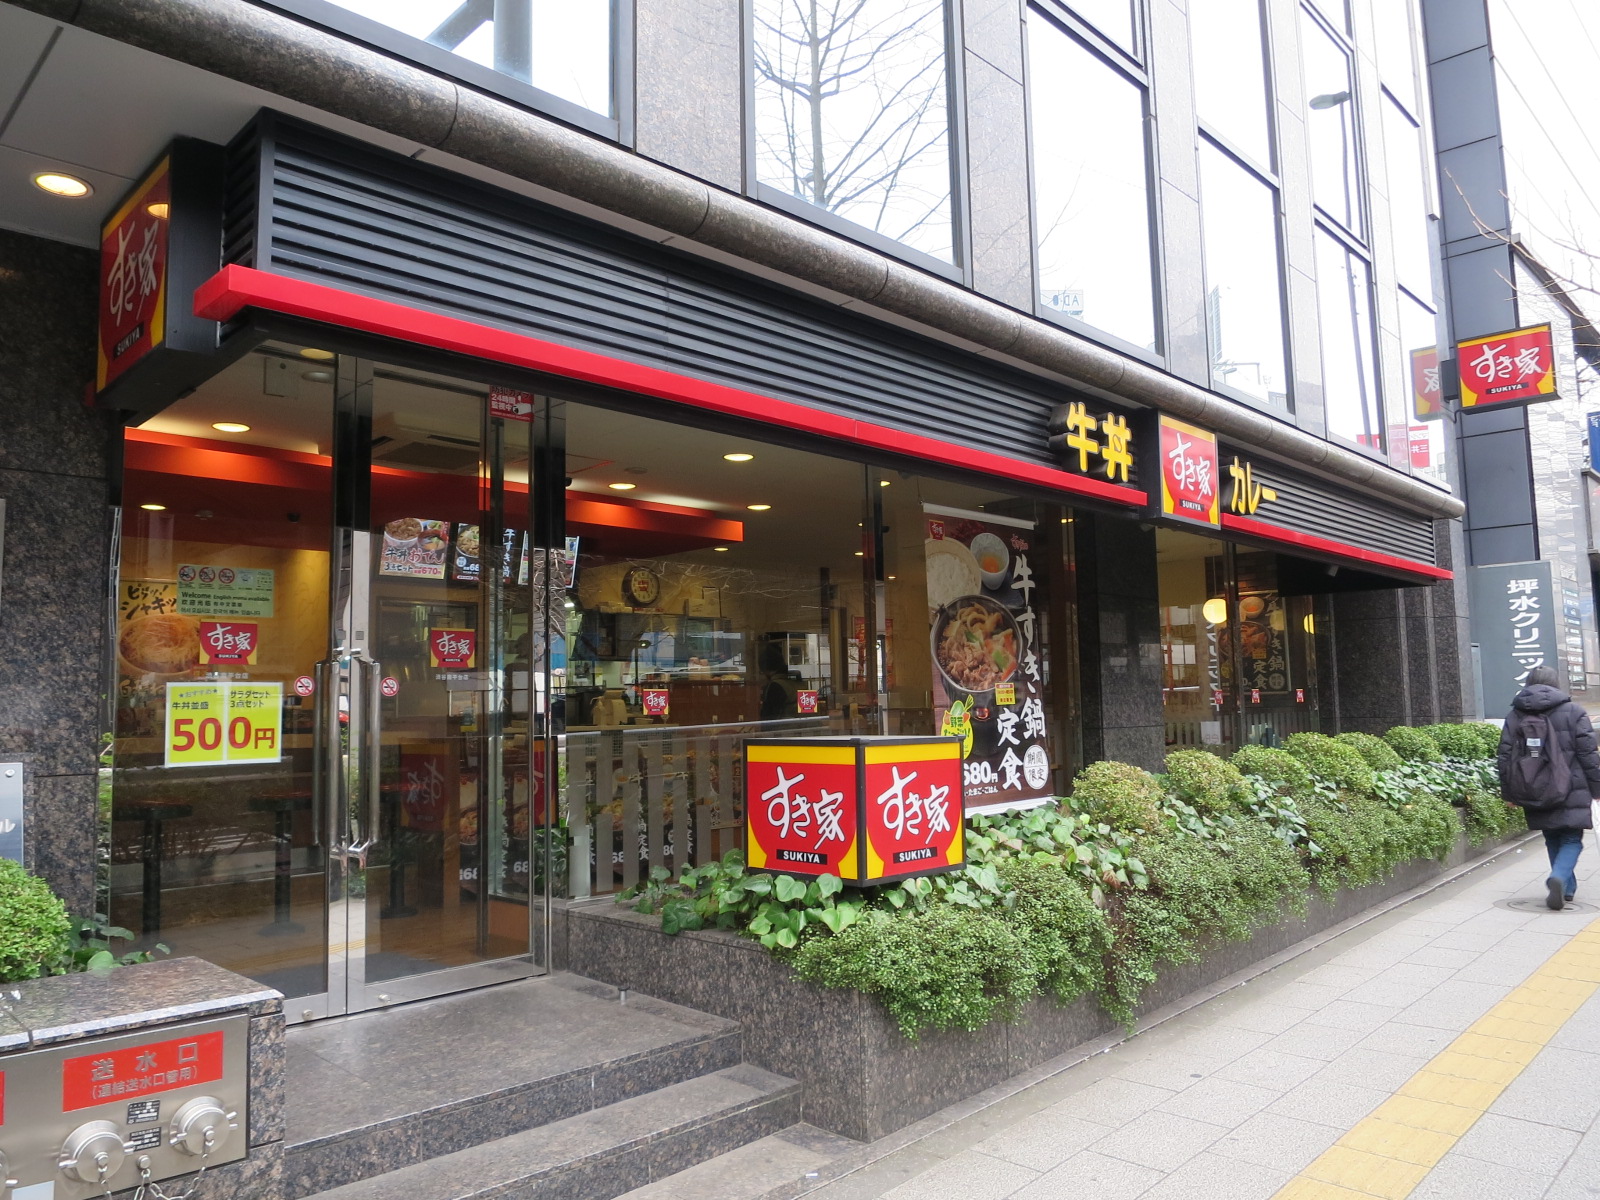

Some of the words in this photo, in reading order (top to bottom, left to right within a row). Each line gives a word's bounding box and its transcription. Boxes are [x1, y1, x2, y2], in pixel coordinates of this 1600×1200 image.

[107, 219, 159, 327] すき家
[116, 326, 141, 357] SUKIYA
[1469, 344, 1542, 383] すき家
[1490, 383, 1523, 394] SUKIYA
[1066, 401, 1134, 483] 牛丼
[1168, 432, 1212, 501] すき家
[1229, 455, 1278, 515] カレー
[1181, 500, 1203, 511] SUKIYA
[181, 591, 212, 599] Welcome
[207, 623, 251, 654] すき家
[436, 631, 471, 658] すき家
[1010, 553, 1047, 740] 牛すき鍋
[172, 702, 209, 710] 牛丼並盛
[230, 690, 271, 699] サラダセット
[230, 700, 265, 708] 3点セット
[172, 716, 275, 752] 500円
[950, 716, 964, 728] 野菜
[997, 707, 1024, 791] 定食
[761, 764, 846, 850] すき家
[877, 764, 951, 845] すき家
[783, 849, 821, 864] SUKIYA
[899, 849, 932, 863] SUKIYA
[91, 1042, 199, 1082] 送水口
